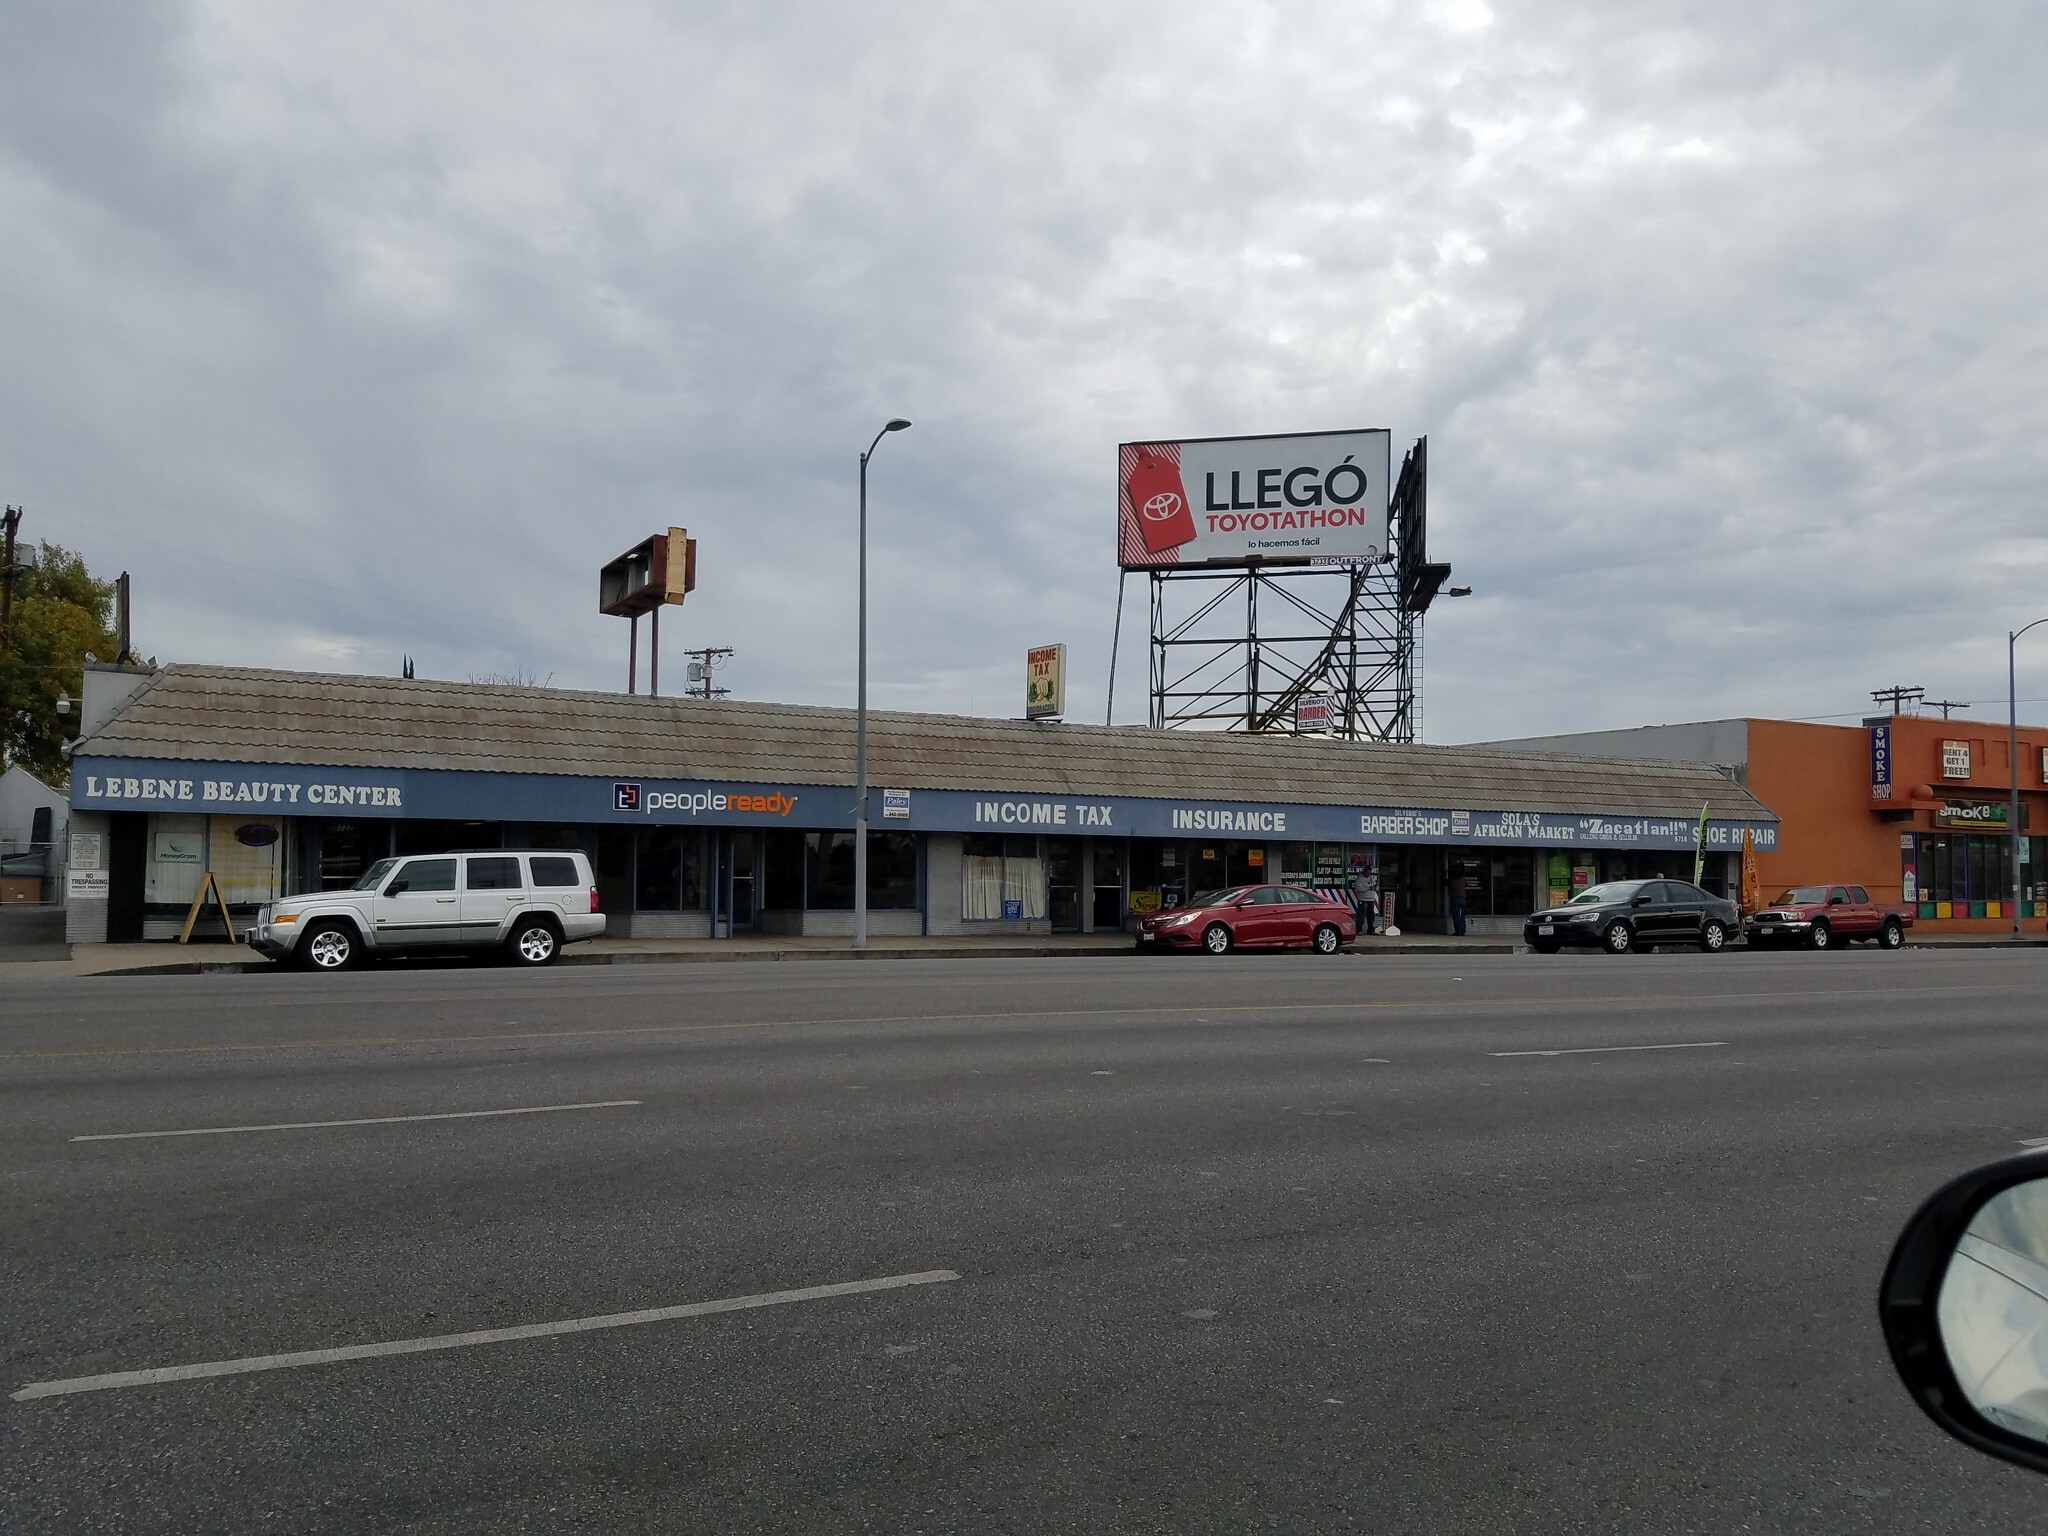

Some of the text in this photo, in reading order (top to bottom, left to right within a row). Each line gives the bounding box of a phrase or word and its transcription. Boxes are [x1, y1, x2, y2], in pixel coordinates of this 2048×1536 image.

[1205, 455, 1368, 512] LLEGÓ
[1206, 507, 1365, 533] TOYOTATHON
[1248, 536, 1320, 549] lo hacemos fácil
[1329, 555, 1383, 565] OUTFRONT
[1028, 648, 1057, 665] INCOME
[1034, 662, 1050, 676] TAX
[1299, 706, 1326, 720] BARBER
[1875, 727, 1886, 782] SMOKE
[1946, 757, 1959, 765] GET
[1944, 766, 1970, 776] FREE!!
[86, 776, 402, 807] LEBENE BEAUTY CENTER
[1872, 783, 1891, 799] SHOP
[647, 789, 795, 817] peopleready
[975, 802, 1113, 826] INCOME TAX
[1172, 808, 1286, 832] INSURANCE
[1394, 809, 1422, 817] SILVERIO'S
[1501, 812, 1540, 826] SOLA'S
[1361, 815, 1449, 836] BARBER SHOP
[1473, 823, 1524, 838] AFRICAN
[1527, 825, 1575, 839] MARKET
